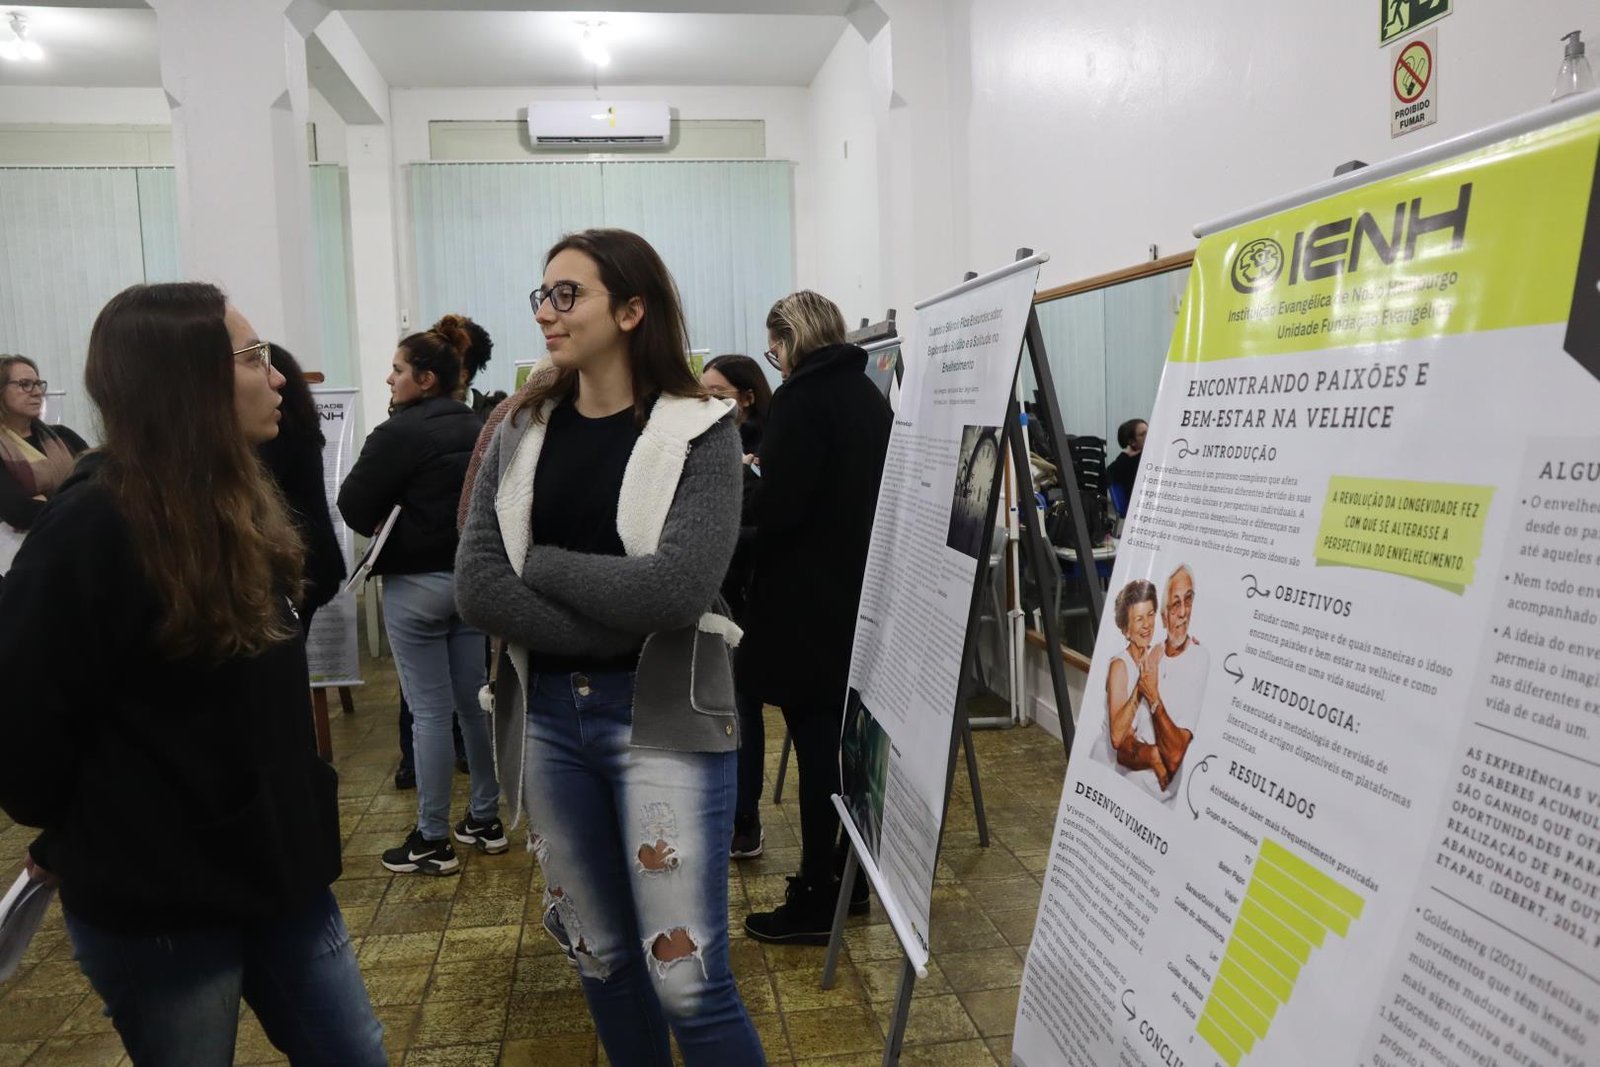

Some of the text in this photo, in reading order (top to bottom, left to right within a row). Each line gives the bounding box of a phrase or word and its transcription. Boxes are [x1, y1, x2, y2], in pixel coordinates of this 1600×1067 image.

[1395, 99, 1430, 119] PROIBIDO
[1399, 113, 1425, 129] FUMAR
[1288, 183, 1473, 286] IENH
[1278, 294, 1332, 315] Evangélica
[1277, 320, 1319, 339] Unidade
[1187, 363, 1430, 398] ENCONTRANDO PAIXÕES E
[1180, 405, 1395, 428] BEM-ESTAR NA VELHICE
[1202, 444, 1277, 462] INTRODUÇÃO
[1539, 461, 1600, 482] ALGU
[1332, 491, 1480, 518] A REVOLUÇÃO DA LONGEVIDADE FEZ
[1530, 495, 1542, 509] O
[1324, 535, 1372, 554] PERSPECTIVA
[1374, 543, 1385, 558] DO
[1344, 515, 1449, 541] COM QUE SE ALTERASSE A
[1525, 519, 1561, 535] desde
[1563, 525, 1579, 537] os
[1520, 544, 1593, 565] até aqueles
[1275, 585, 1353, 618] OBJETIVOS
[1513, 572, 1542, 590] Nem
[1545, 578, 1574, 595] todo
[1507, 597, 1598, 625] acompanhado
[1253, 609, 1279, 626] Estudar
[1301, 625, 1330, 641] porque
[1336, 632, 1347, 646] de
[1348, 636, 1372, 654] quais
[1373, 644, 1416, 667] maneiras
[1417, 658, 1424, 669] o
[1425, 657, 1454, 678] idoso
[1502, 626, 1512, 639] A
[1515, 628, 1545, 647] ideia
[1548, 636, 1565, 652] do
[1245, 644, 1258, 656] isso
[1258, 648, 1295, 670] influencia
[1295, 662, 1307, 674] em
[1308, 666, 1326, 680] uma
[1327, 671, 1345, 687] vida
[1249, 628, 1279, 645] encontra
[1280, 635, 1308, 655] paixões
[1314, 646, 1331, 661] bem
[1333, 655, 1355, 670] estar
[1355, 661, 1367, 673] na
[1369, 663, 1402, 685] velhice
[1403, 675, 1410, 687] e
[1410, 678, 1438, 696] como
[1495, 651, 1546, 673] permeia
[1549, 665, 1558, 676] o
[1251, 677, 1361, 734] METODOLOGIA:
[1490, 674, 1512, 689] nas
[1513, 679, 1581, 709] diferentes
[1231, 696, 1389, 775] Foi executada metodologia de revisão de
[1485, 696, 1591, 740] vida de cada um.
[1227, 713, 1412, 809] literatura de artigos disponíveis em plataformas
[1466, 746, 1581, 800] AS EXPERIÊNCIAS
[1229, 760, 1317, 820] RESULTADOS
[1456, 782, 1573, 841] SÃO GANHOS QUE
[1461, 764, 1476, 779] OS
[1479, 769, 1535, 802] SABERES
[1538, 795, 1600, 831] ACUMUL
[1075, 781, 1169, 855] DESENVOLVIMENTO
[1209, 784, 1379, 892] Atividades de lazer mais frequentemente praticadas
[1452, 800, 1562, 858] OPORTUNIDADES
[1442, 837, 1541, 894] ABANDONADOS
[1544, 885, 1566, 907] EM
[1447, 817, 1527, 864] REALIZAÇÃO
[1530, 857, 1549, 875] DE
[1554, 867, 1600, 900] PROJE
[1422, 908, 1487, 957] Goldenberg
[1489, 946, 1529, 980] (2011)
[1528, 973, 1582, 1015] enfatiza
[1409, 952, 1461, 992] mulheres
[1463, 988, 1515, 1028] maduras
[1517, 1023, 1527, 1036] a
[1529, 1030, 1560, 1058] uma
[1415, 931, 1588, 1046] movimentos que têm levado
[1394, 993, 1456, 1043] processo de
[1401, 973, 1501, 1048] mais significativa
